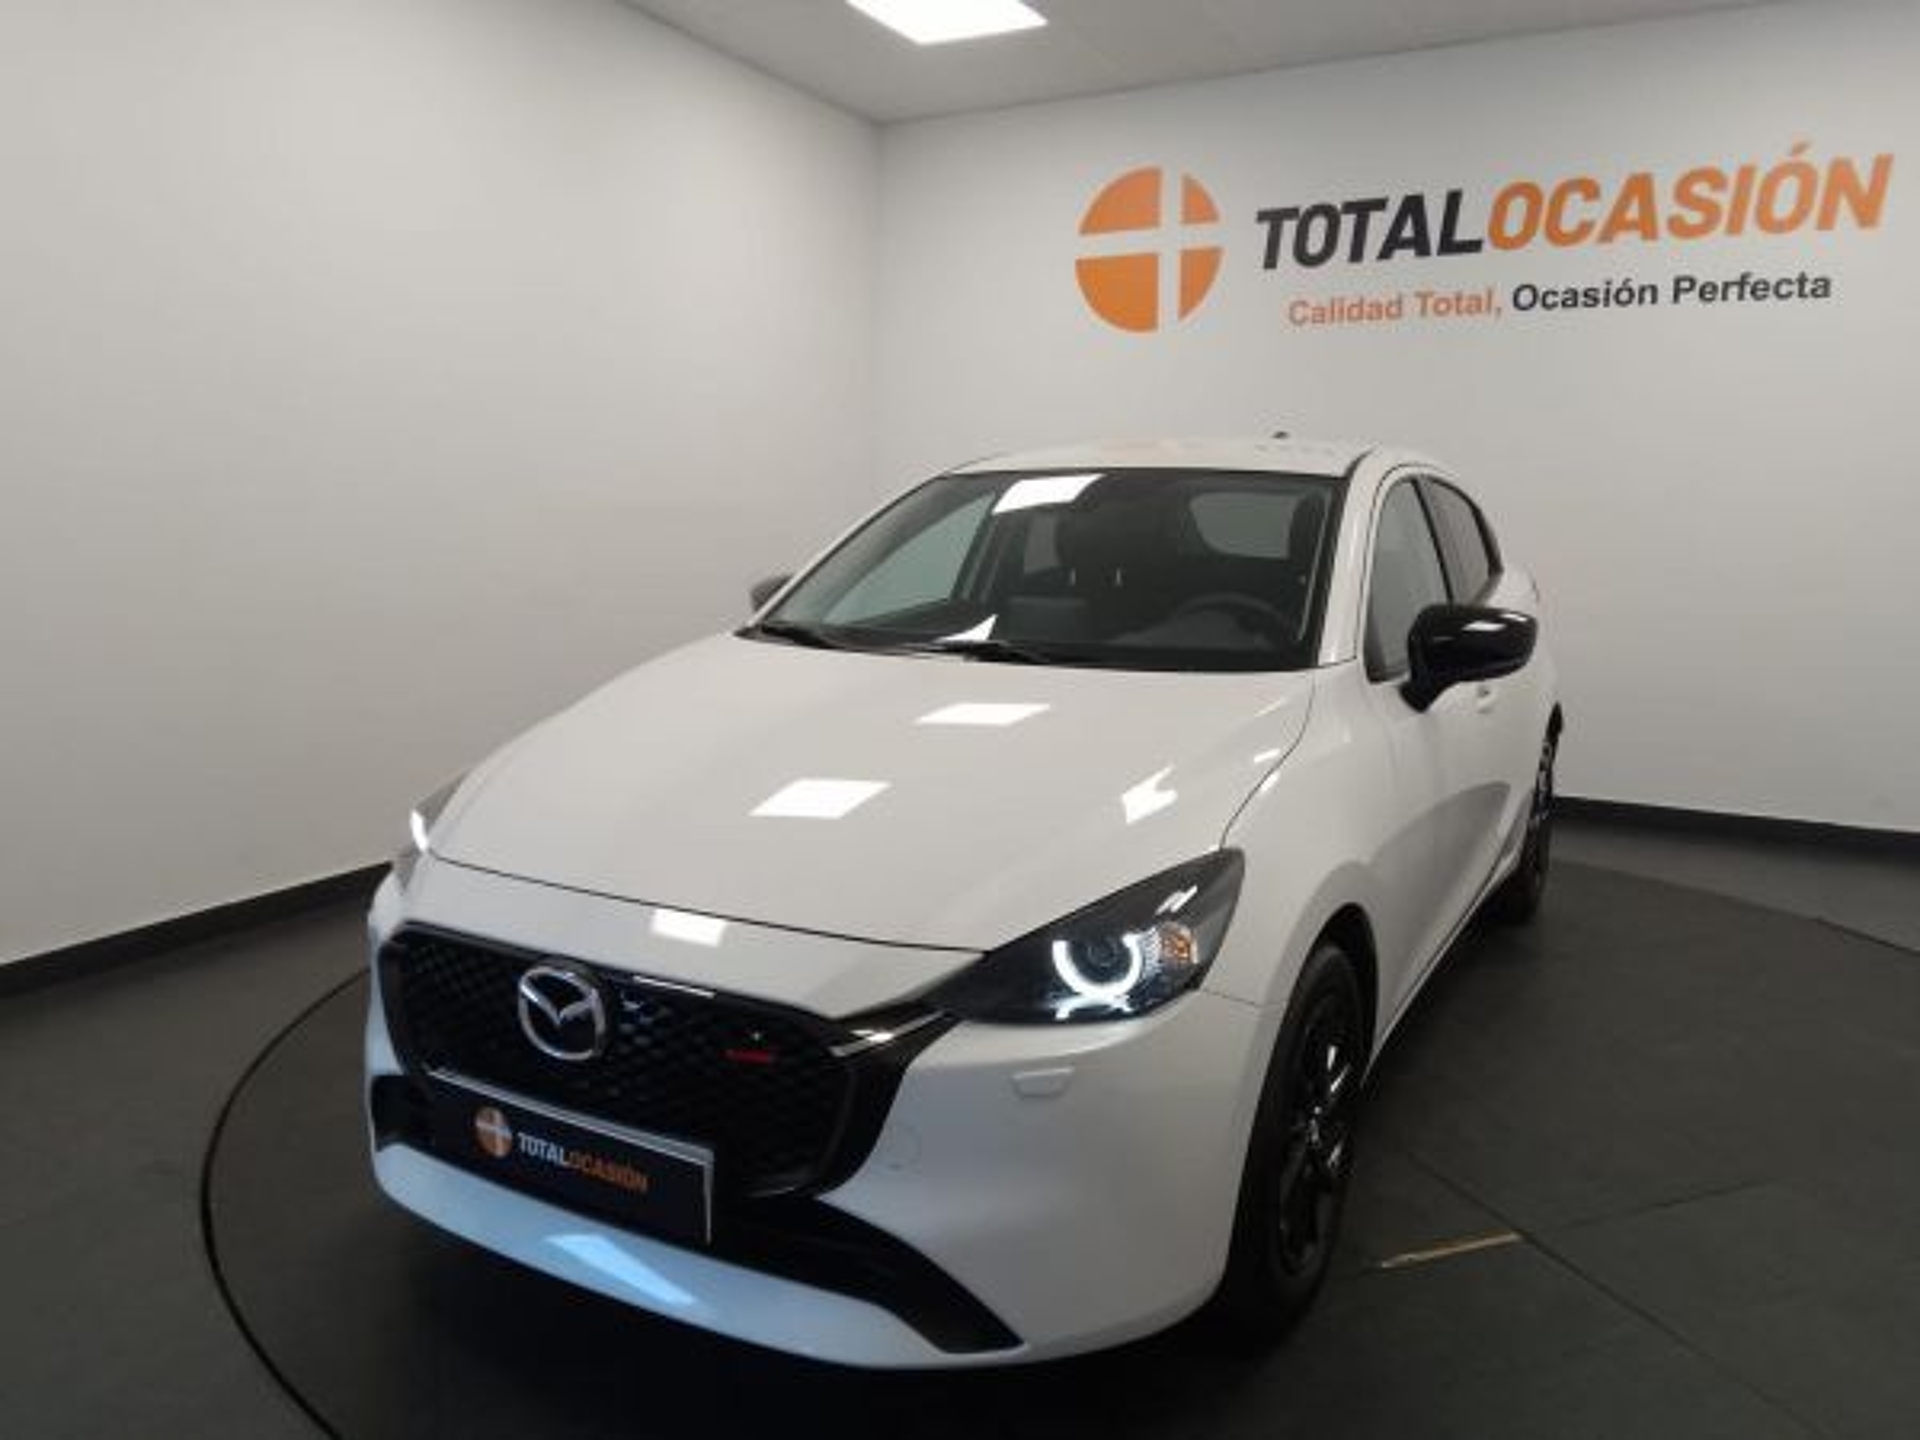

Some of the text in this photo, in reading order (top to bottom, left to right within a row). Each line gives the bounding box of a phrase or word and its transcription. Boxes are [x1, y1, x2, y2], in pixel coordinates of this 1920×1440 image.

[1256, 142, 1894, 270] TOTALOCASIÓN
[1288, 270, 1832, 326] Calidad Total, Ocasión Perfecta
